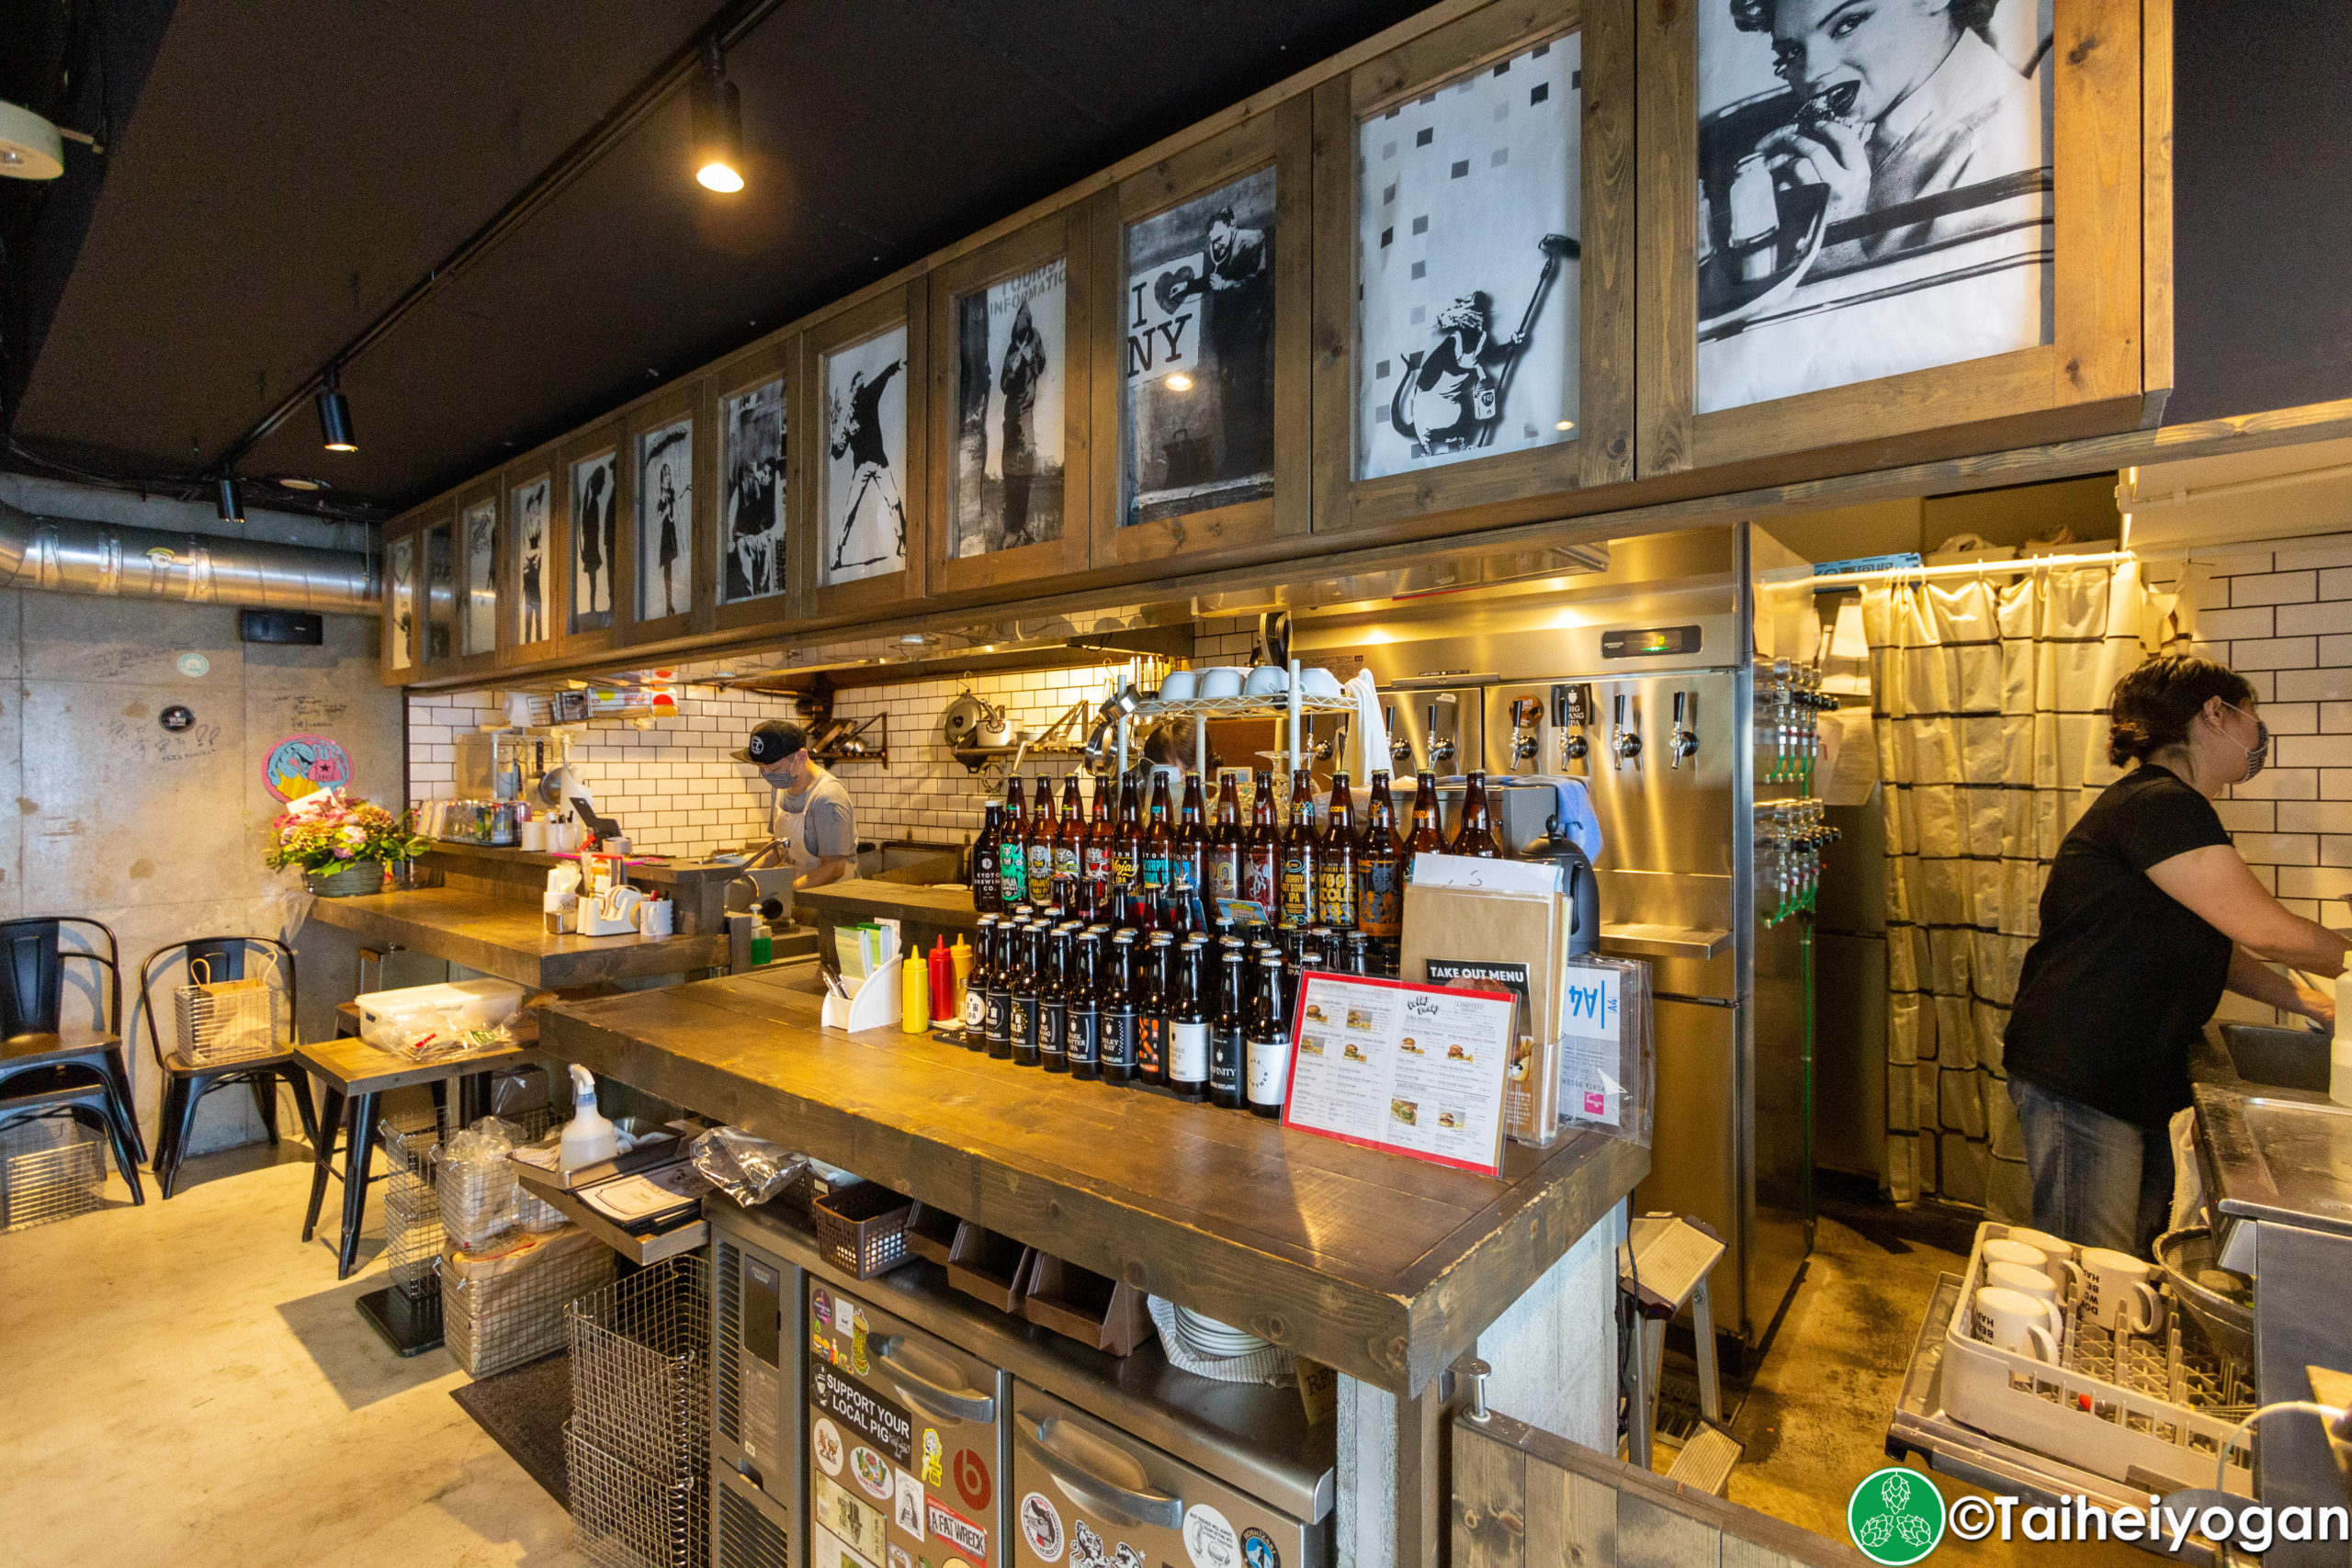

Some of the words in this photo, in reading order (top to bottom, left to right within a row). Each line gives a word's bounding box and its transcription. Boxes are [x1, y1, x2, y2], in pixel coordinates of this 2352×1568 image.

[1132, 281, 1148, 329] I
[1128, 313, 1193, 378] NY
[1285, 874, 1304, 883] SORRY
[1288, 892, 1300, 902] IPA
[1430, 966, 1460, 978] TAKE
[1462, 968, 1487, 979] OUT
[1488, 970, 1524, 982] MENU
[1569, 986, 1599, 1018] A4
[1608, 998, 1618, 1013] A4
[827, 1374, 876, 1416] SUPPORT
[877, 1404, 910, 1438] YOUR
[832, 1394, 868, 1430] LOCAL
[870, 1419, 889, 1443] PIG
[932, 1512, 938, 1529] A
[939, 1514, 954, 1537] FAT
[955, 1522, 985, 1553] WRECK
[1198, 1516, 1212, 1527] FRIENDS
[1220, 1529, 1233, 1538] ALWAYS
[1243, 1529, 1276, 1554] HOSHIZAKI
